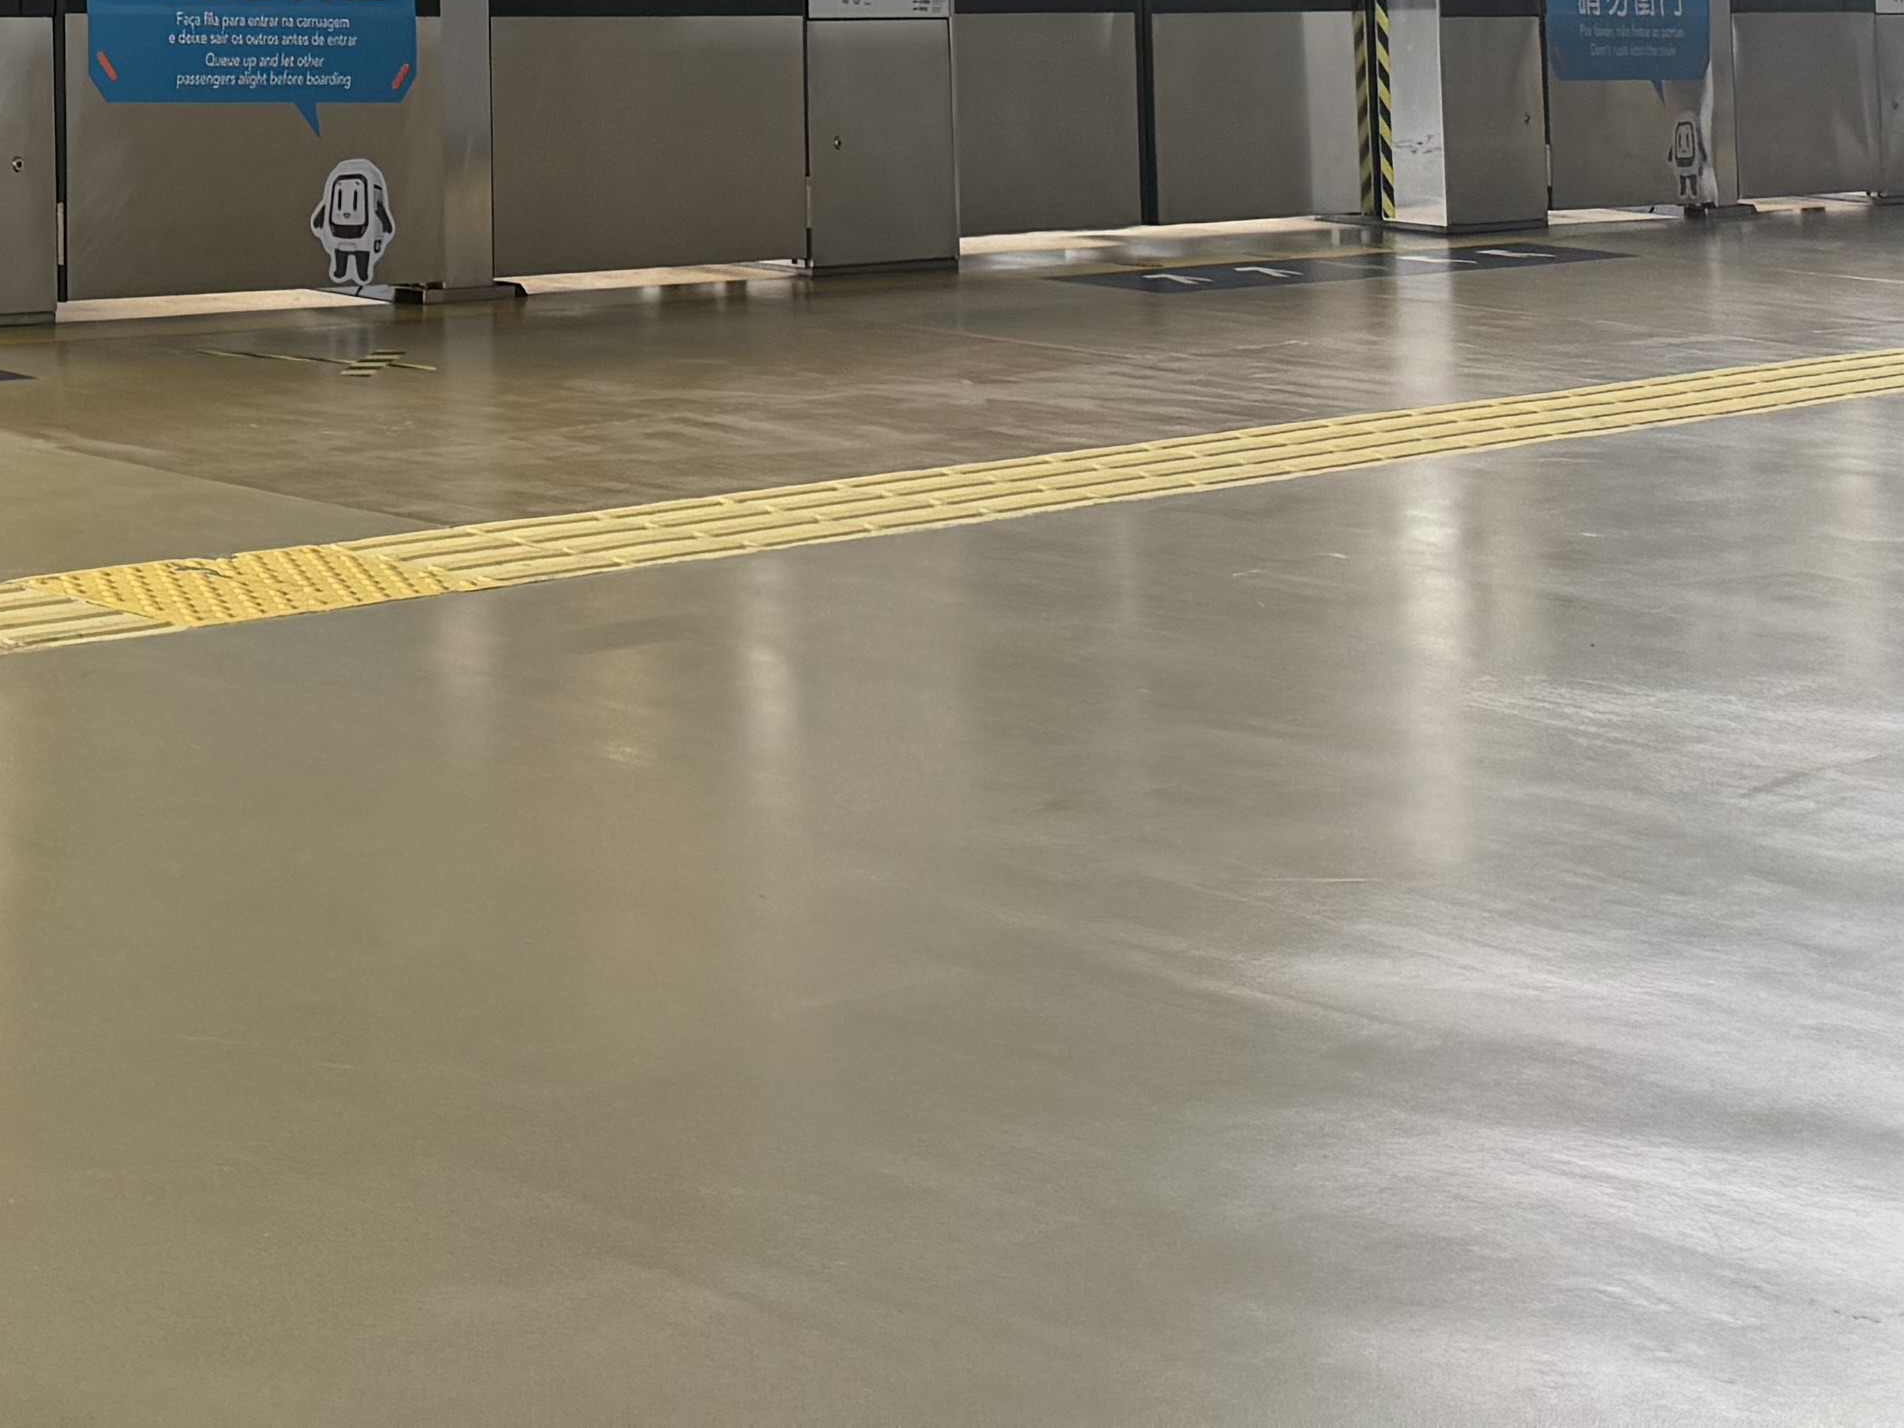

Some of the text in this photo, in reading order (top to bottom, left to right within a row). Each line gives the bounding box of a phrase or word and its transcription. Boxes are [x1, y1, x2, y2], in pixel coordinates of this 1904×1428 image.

[176, 11, 201, 31] Faça
[222, 16, 246, 31] para
[248, 16, 279, 28] entrar
[281, 17, 294, 28] na
[168, 34, 176, 44] e
[231, 34, 243, 45] os
[246, 33, 279, 45] outros
[281, 33, 309, 46] antes
[311, 32, 324, 46] de
[327, 34, 358, 47] entrar
[243, 56, 257, 71] up
[259, 53, 279, 67] and
[281, 52, 295, 67] let
[297, 53, 325, 68] other
[176, 70, 352, 89] passengers alight before boarding
